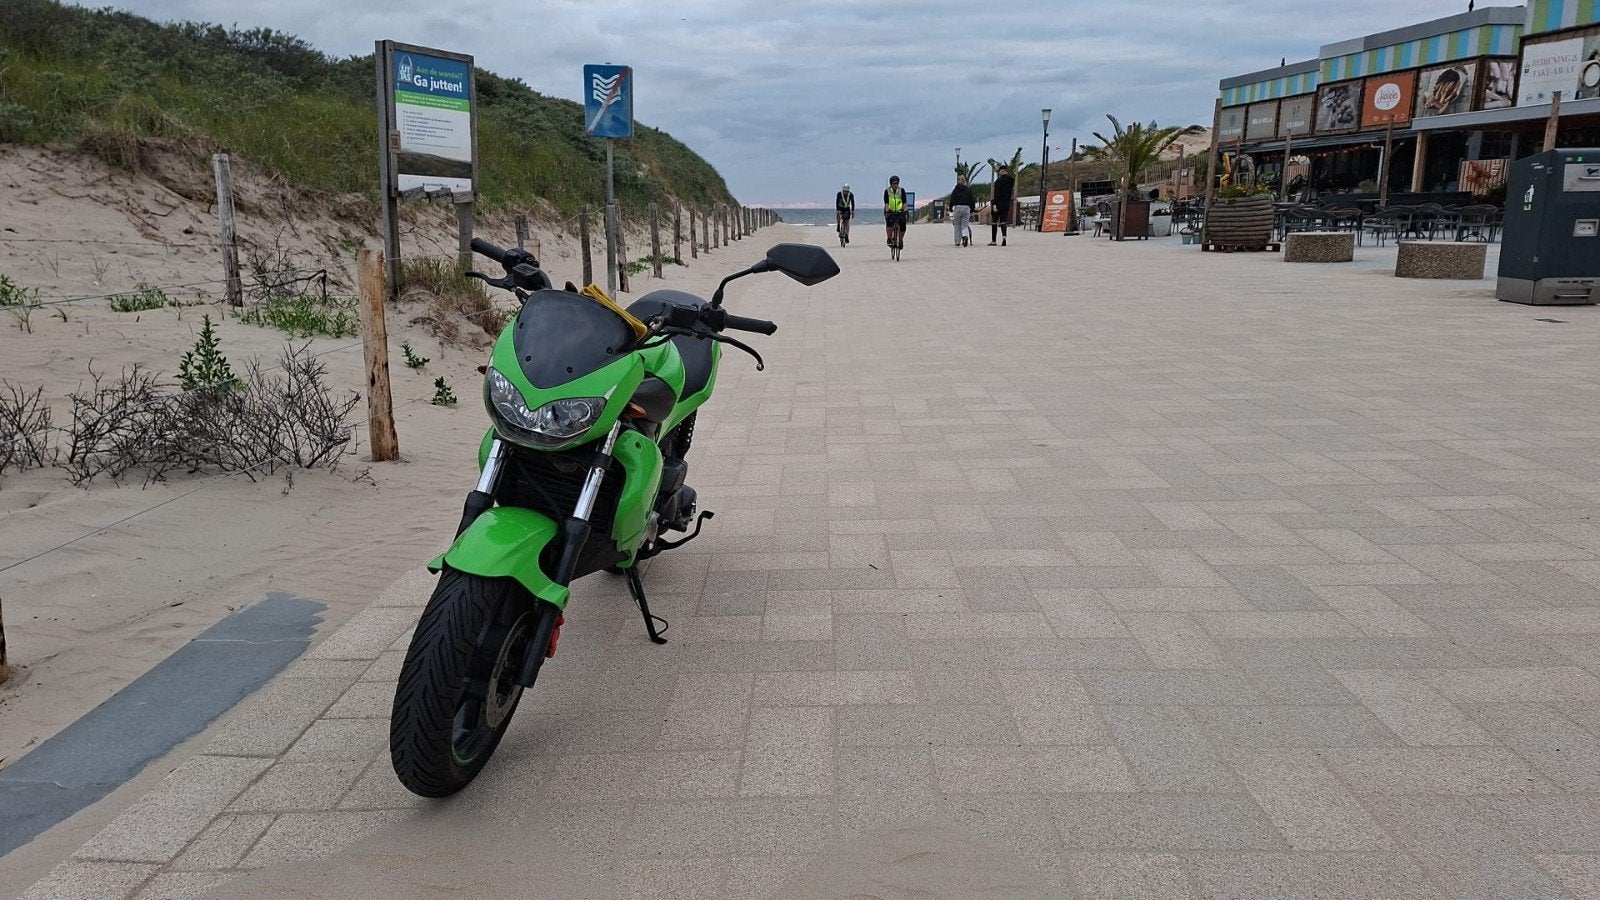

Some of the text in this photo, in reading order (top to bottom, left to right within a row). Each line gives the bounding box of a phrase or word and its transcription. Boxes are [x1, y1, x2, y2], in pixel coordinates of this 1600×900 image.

[400, 65, 411, 73] JUT
[416, 66, 429, 74] Aan
[430, 68, 438, 76] de
[400, 72, 411, 81] TAS
[413, 75, 463, 92] Ga jutten!
